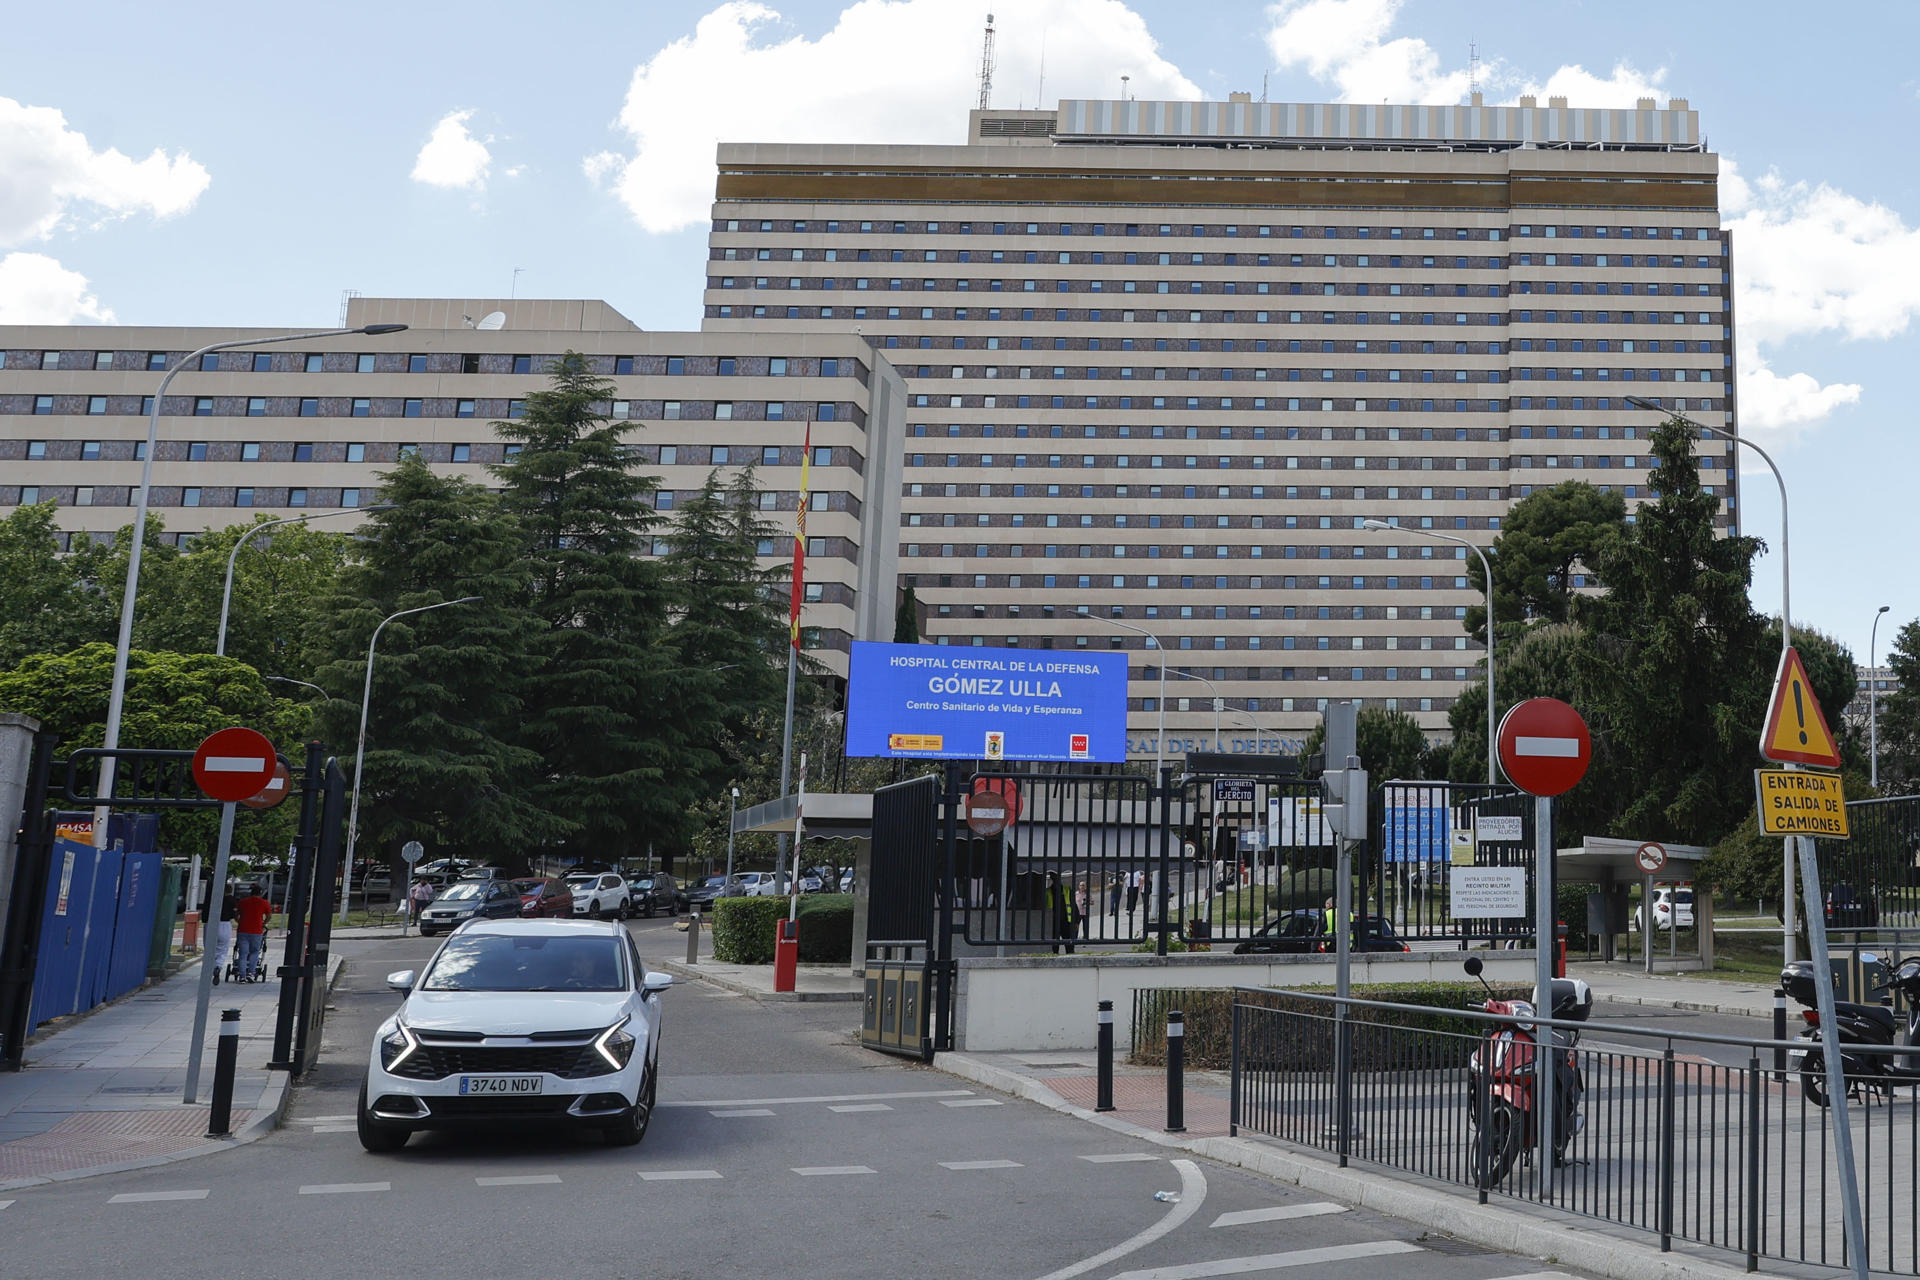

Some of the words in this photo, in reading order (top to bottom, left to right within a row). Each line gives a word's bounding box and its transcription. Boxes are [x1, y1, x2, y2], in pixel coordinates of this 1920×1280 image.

[890, 656, 949, 669] HOSPITAL
[951, 659, 1007, 671] CENTRAL
[1009, 661, 1026, 672] DE
[1028, 662, 1044, 673] LA
[1046, 663, 1100, 675] DEFENSA
[928, 672, 1003, 696] GÓMEZ
[1009, 679, 1063, 698] ULLA
[906, 700, 940, 711] Centro
[942, 701, 986, 712] Sanitario
[987, 703, 1000, 713] de
[1001, 703, 1023, 713] Vida
[1025, 705, 1032, 716] y
[1033, 704, 1083, 716] Esperanza
[1168, 738, 1195, 753] DE
[1767, 775, 1827, 792] ENTRADA
[1831, 781, 1838, 793] Y
[1774, 795, 1821, 811] SALIDA
[1825, 798, 1839, 813] DE
[56, 823, 93, 832] EMSA
[1776, 816, 1841, 832] CAMIONES
[471, 1079, 508, 1093] 3740
[511, 1079, 539, 1092] NDV
